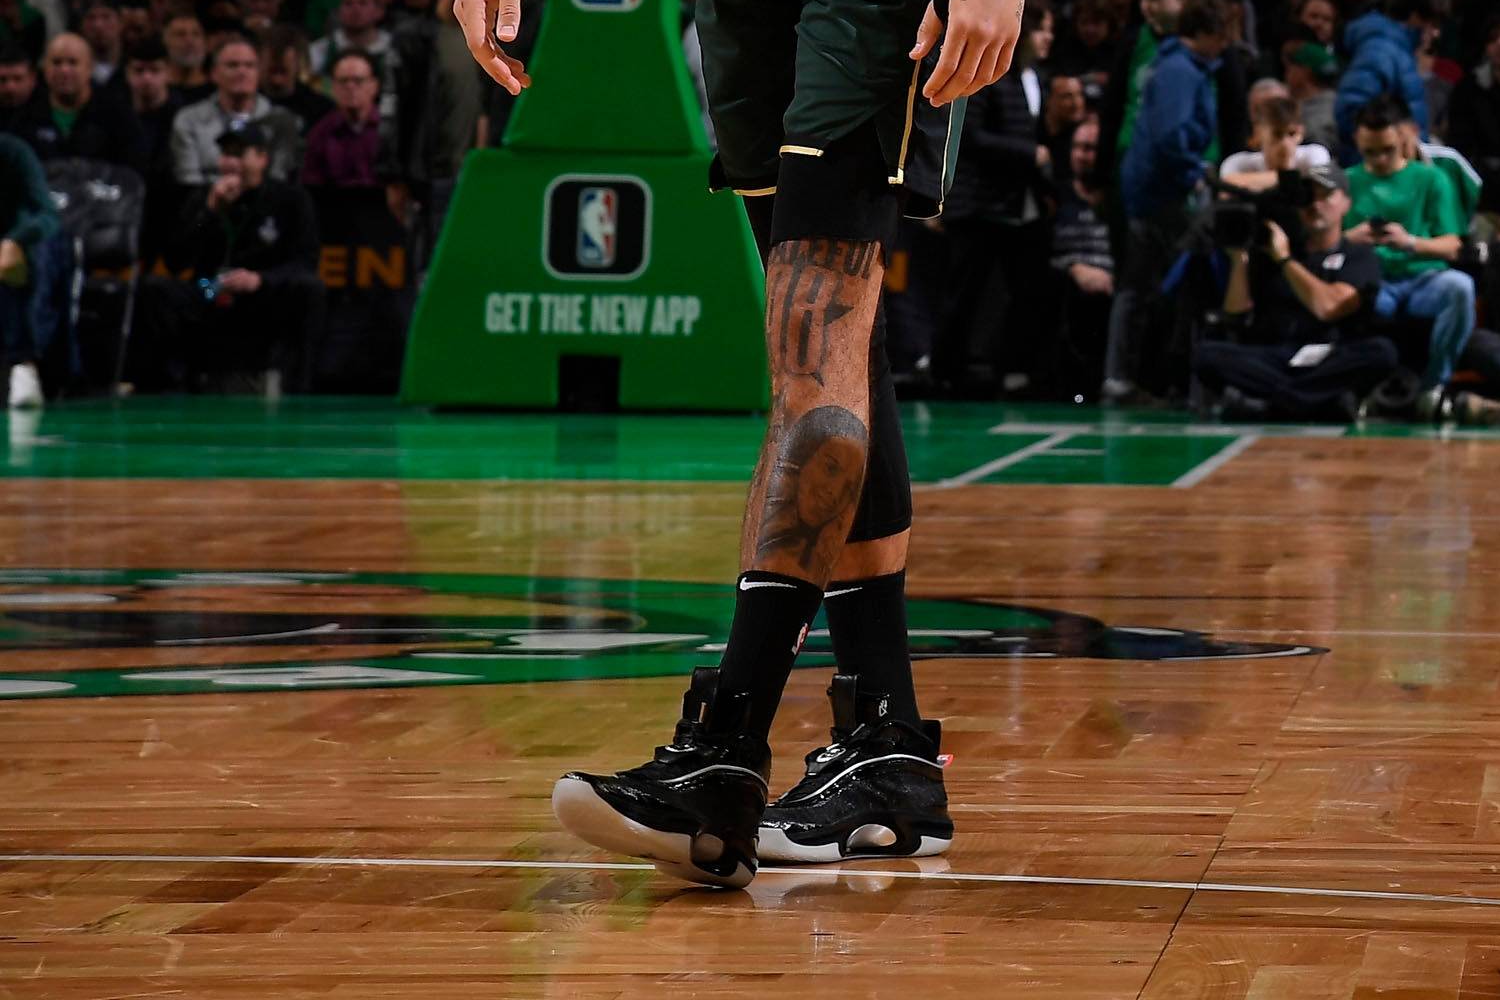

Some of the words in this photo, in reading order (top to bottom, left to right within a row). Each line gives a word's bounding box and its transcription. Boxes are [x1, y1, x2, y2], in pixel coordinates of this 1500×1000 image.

[484, 292, 532, 333] GET
[539, 293, 586, 334] THE
[590, 294, 648, 335] NEW
[650, 295, 701, 336] APP
